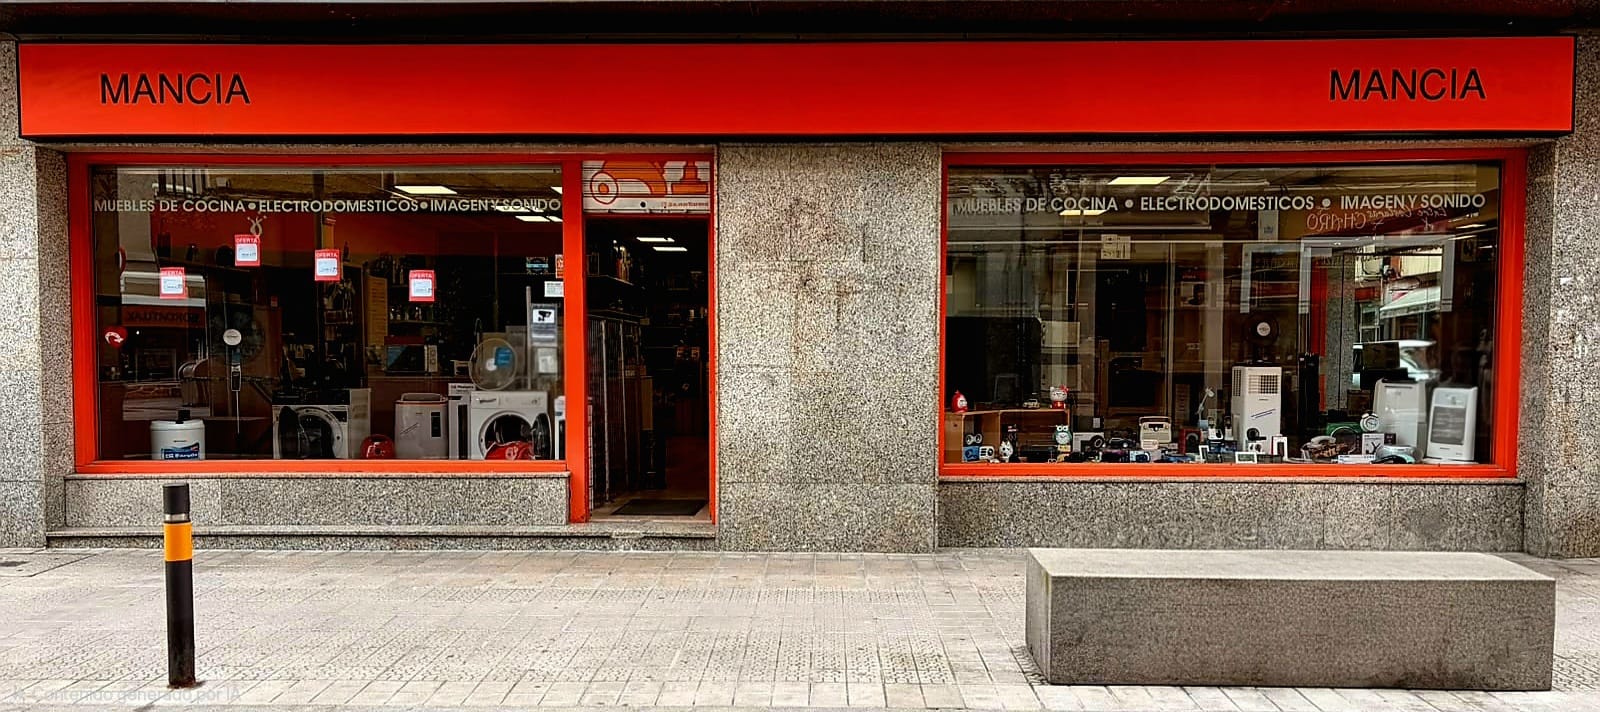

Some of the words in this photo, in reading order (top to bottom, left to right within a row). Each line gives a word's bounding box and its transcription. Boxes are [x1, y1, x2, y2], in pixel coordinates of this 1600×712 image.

[99, 73, 251, 105] MANCIA
[1329, 68, 1486, 101] MANCIA
[95, 199, 155, 213] MUEBLES
[159, 199, 180, 213] DE
[182, 199, 246, 213] COCINA
[258, 199, 419, 213] ELECTRODOMESTICOS
[430, 199, 489, 213] IMAGEN
[489, 199, 501, 213] Y
[502, 198, 562, 213] SONIDO
[956, 197, 1021, 212] MUEBLES
[1026, 197, 1048, 212] DE
[1050, 196, 1118, 212] COCINA
[1140, 195, 1315, 211] ELECTRODOMESTICOS
[1340, 194, 1405, 210] IMAGEN
[1405, 194, 1419, 210] Y
[1420, 193, 1486, 209] SONIDO
